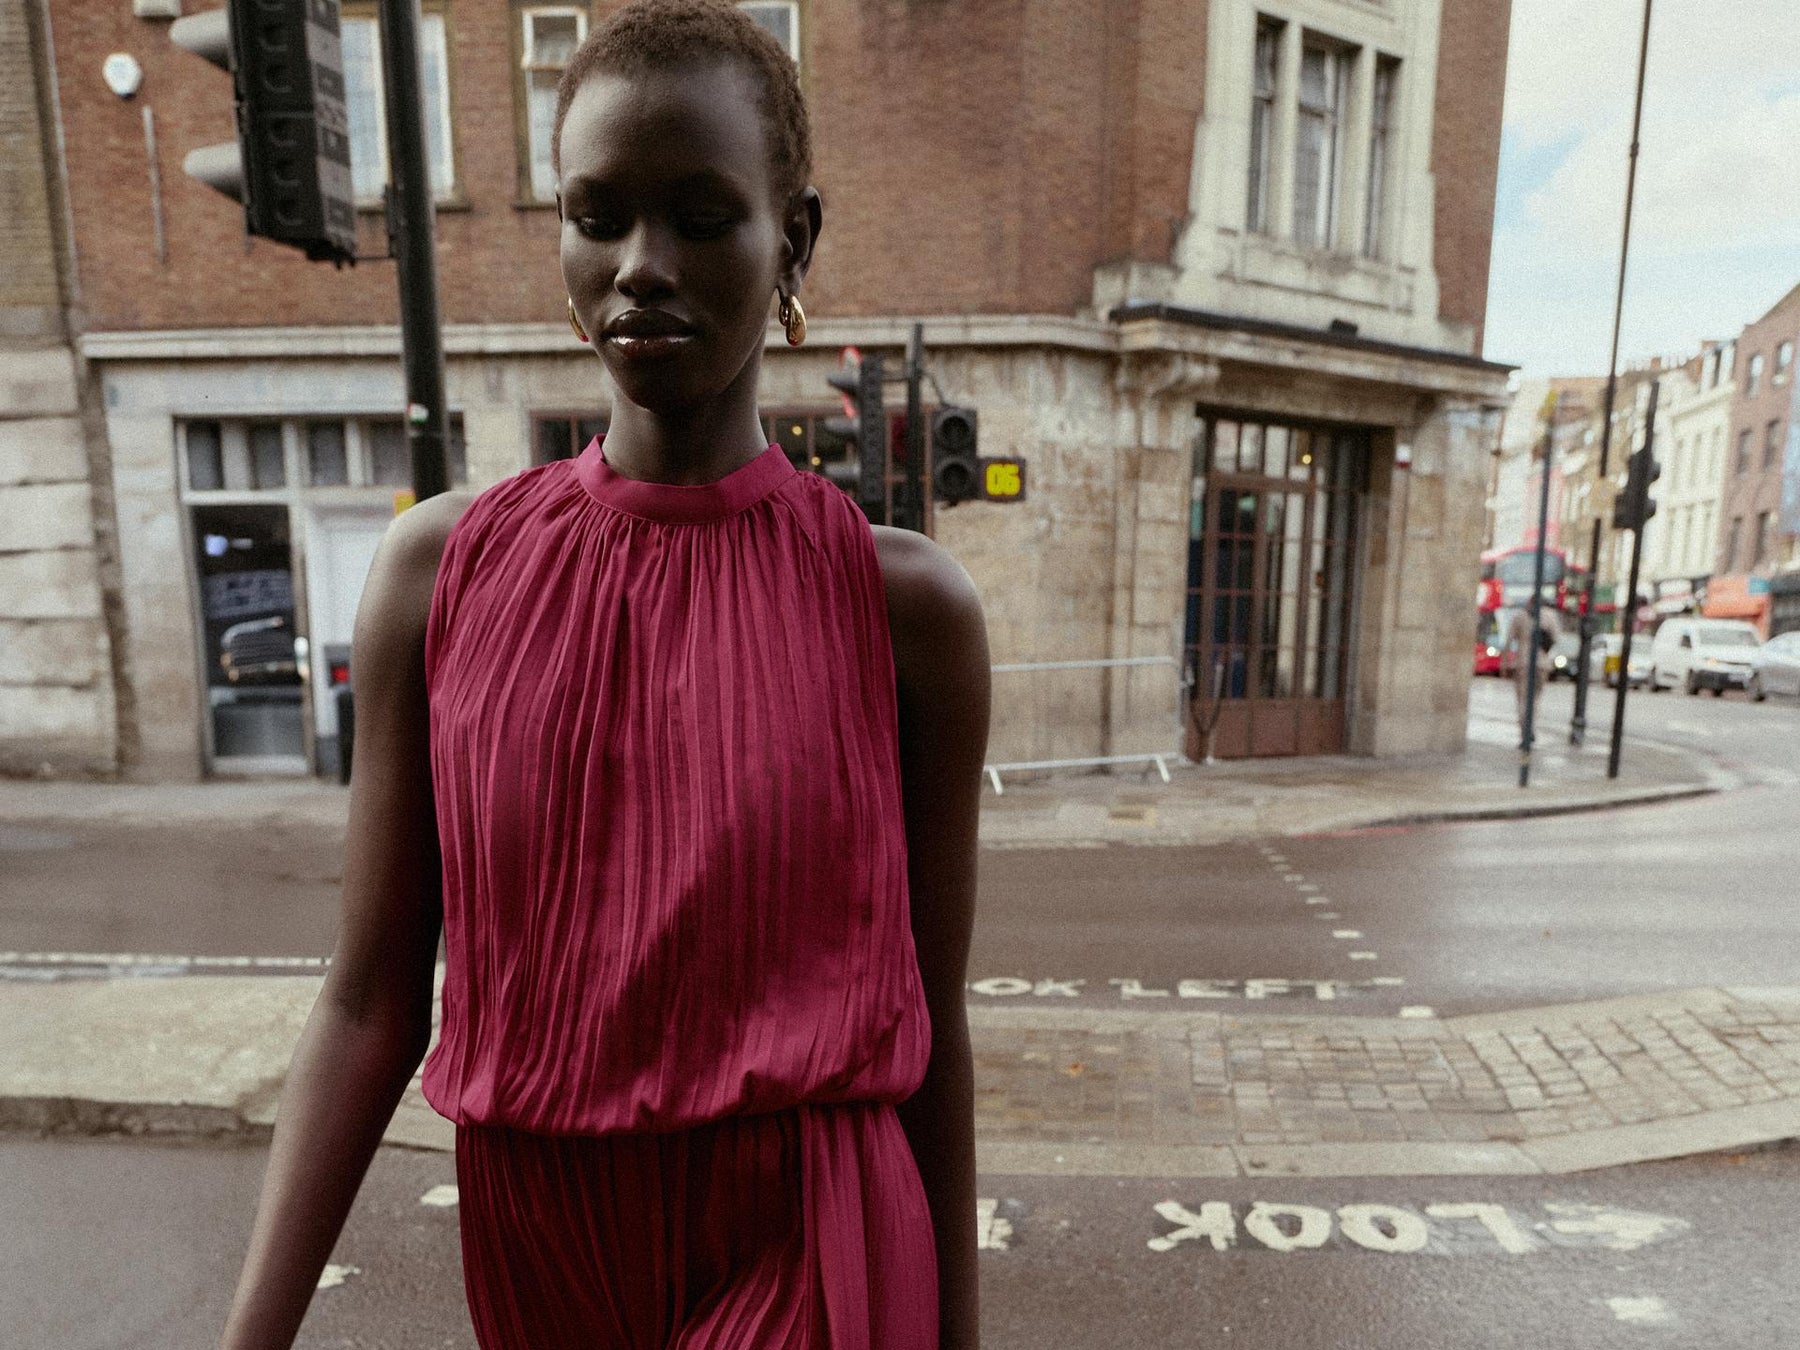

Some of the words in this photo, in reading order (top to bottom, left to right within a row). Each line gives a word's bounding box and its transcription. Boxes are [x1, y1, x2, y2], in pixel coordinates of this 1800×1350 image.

[987, 463, 1020, 496] 06
[965, 977, 1086, 998] OK
[1108, 977, 1405, 1000] LEFT
[1147, 1201, 1537, 1253] LOOK
